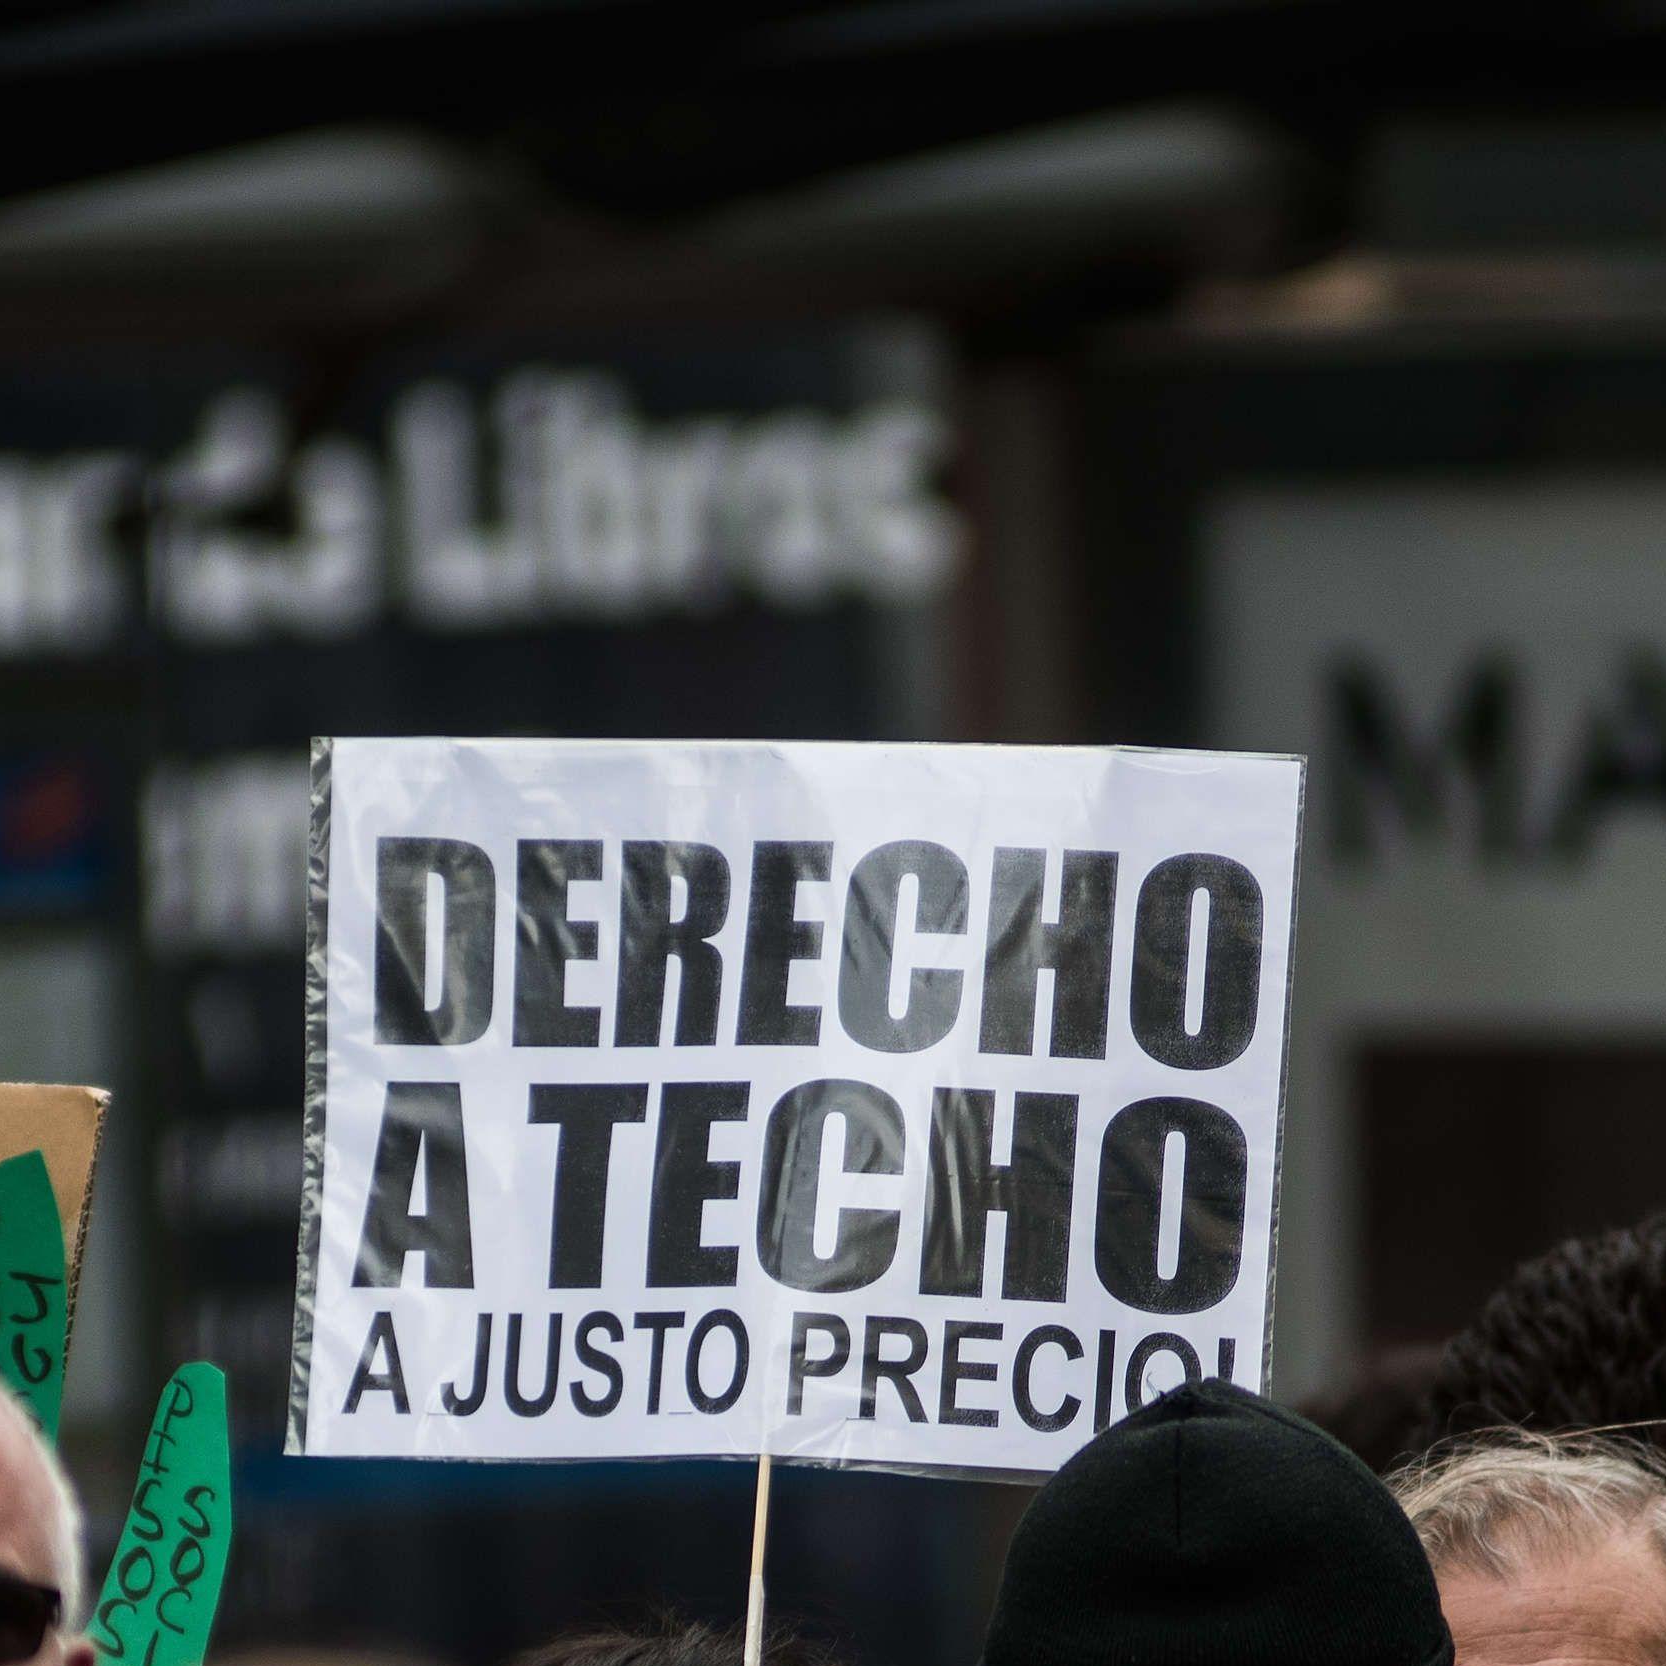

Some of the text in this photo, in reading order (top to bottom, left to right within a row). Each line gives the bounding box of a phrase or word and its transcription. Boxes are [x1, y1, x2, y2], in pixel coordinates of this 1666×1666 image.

[373, 836, 1264, 1071] DERECHO
[350, 1078, 1249, 1315] A TECHO
[341, 1310, 411, 1416] A
[440, 1307, 751, 1418] JUSTO
[93, 1378, 195, 1660] PISOS
